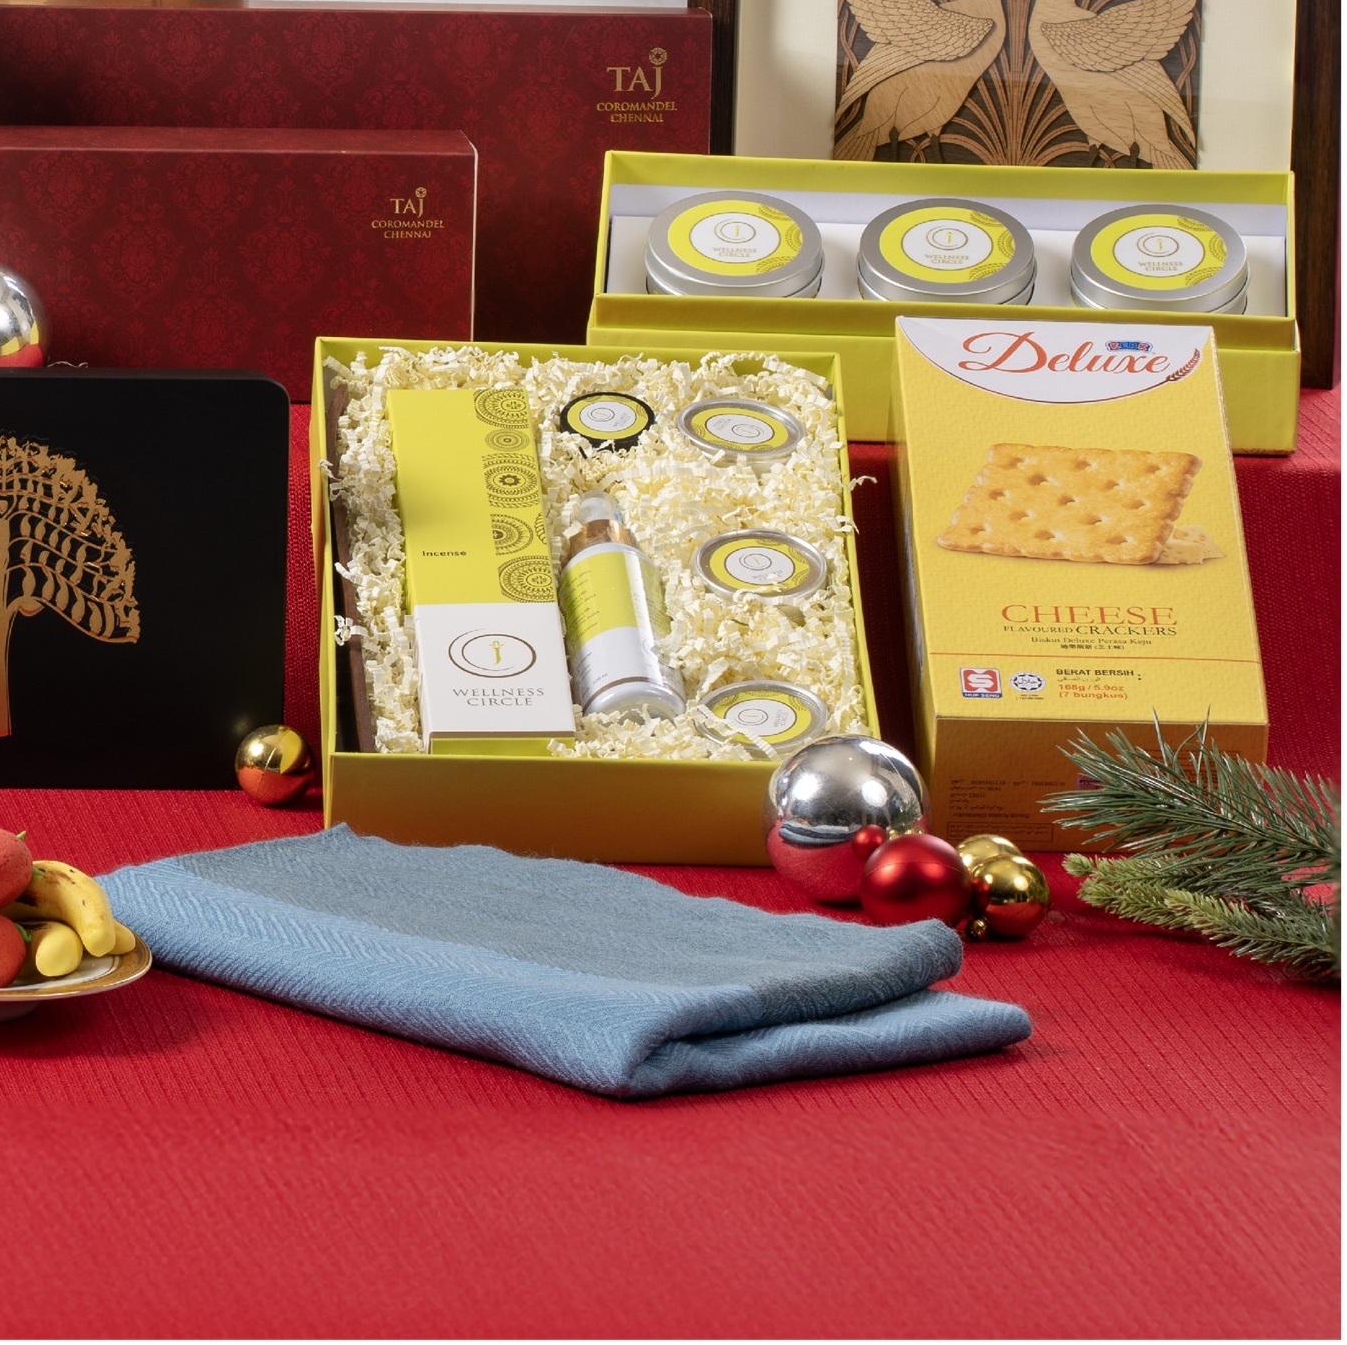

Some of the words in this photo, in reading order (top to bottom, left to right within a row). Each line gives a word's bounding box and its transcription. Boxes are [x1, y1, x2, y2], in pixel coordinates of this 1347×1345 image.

[606, 66, 663, 100] TAJ
[596, 102, 678, 112] COROMANDEL
[610, 113, 664, 123] CHENNAI
[390, 198, 424, 218] TAJ
[371, 220, 445, 229] COROMANDEL
[384, 231, 432, 239] CHENNAI
[712, 246, 757, 254] WELLNESS
[924, 253, 969, 261] WELLNESS
[958, 331, 1171, 374] Deluxe
[1001, 604, 1178, 626] CHEESE
[1075, 625, 1177, 636] CRACKERS
[453, 688, 544, 697] WELLNESS
[1073, 692, 1128, 700] bungkus)
[467, 697, 533, 706] CIRCLE
